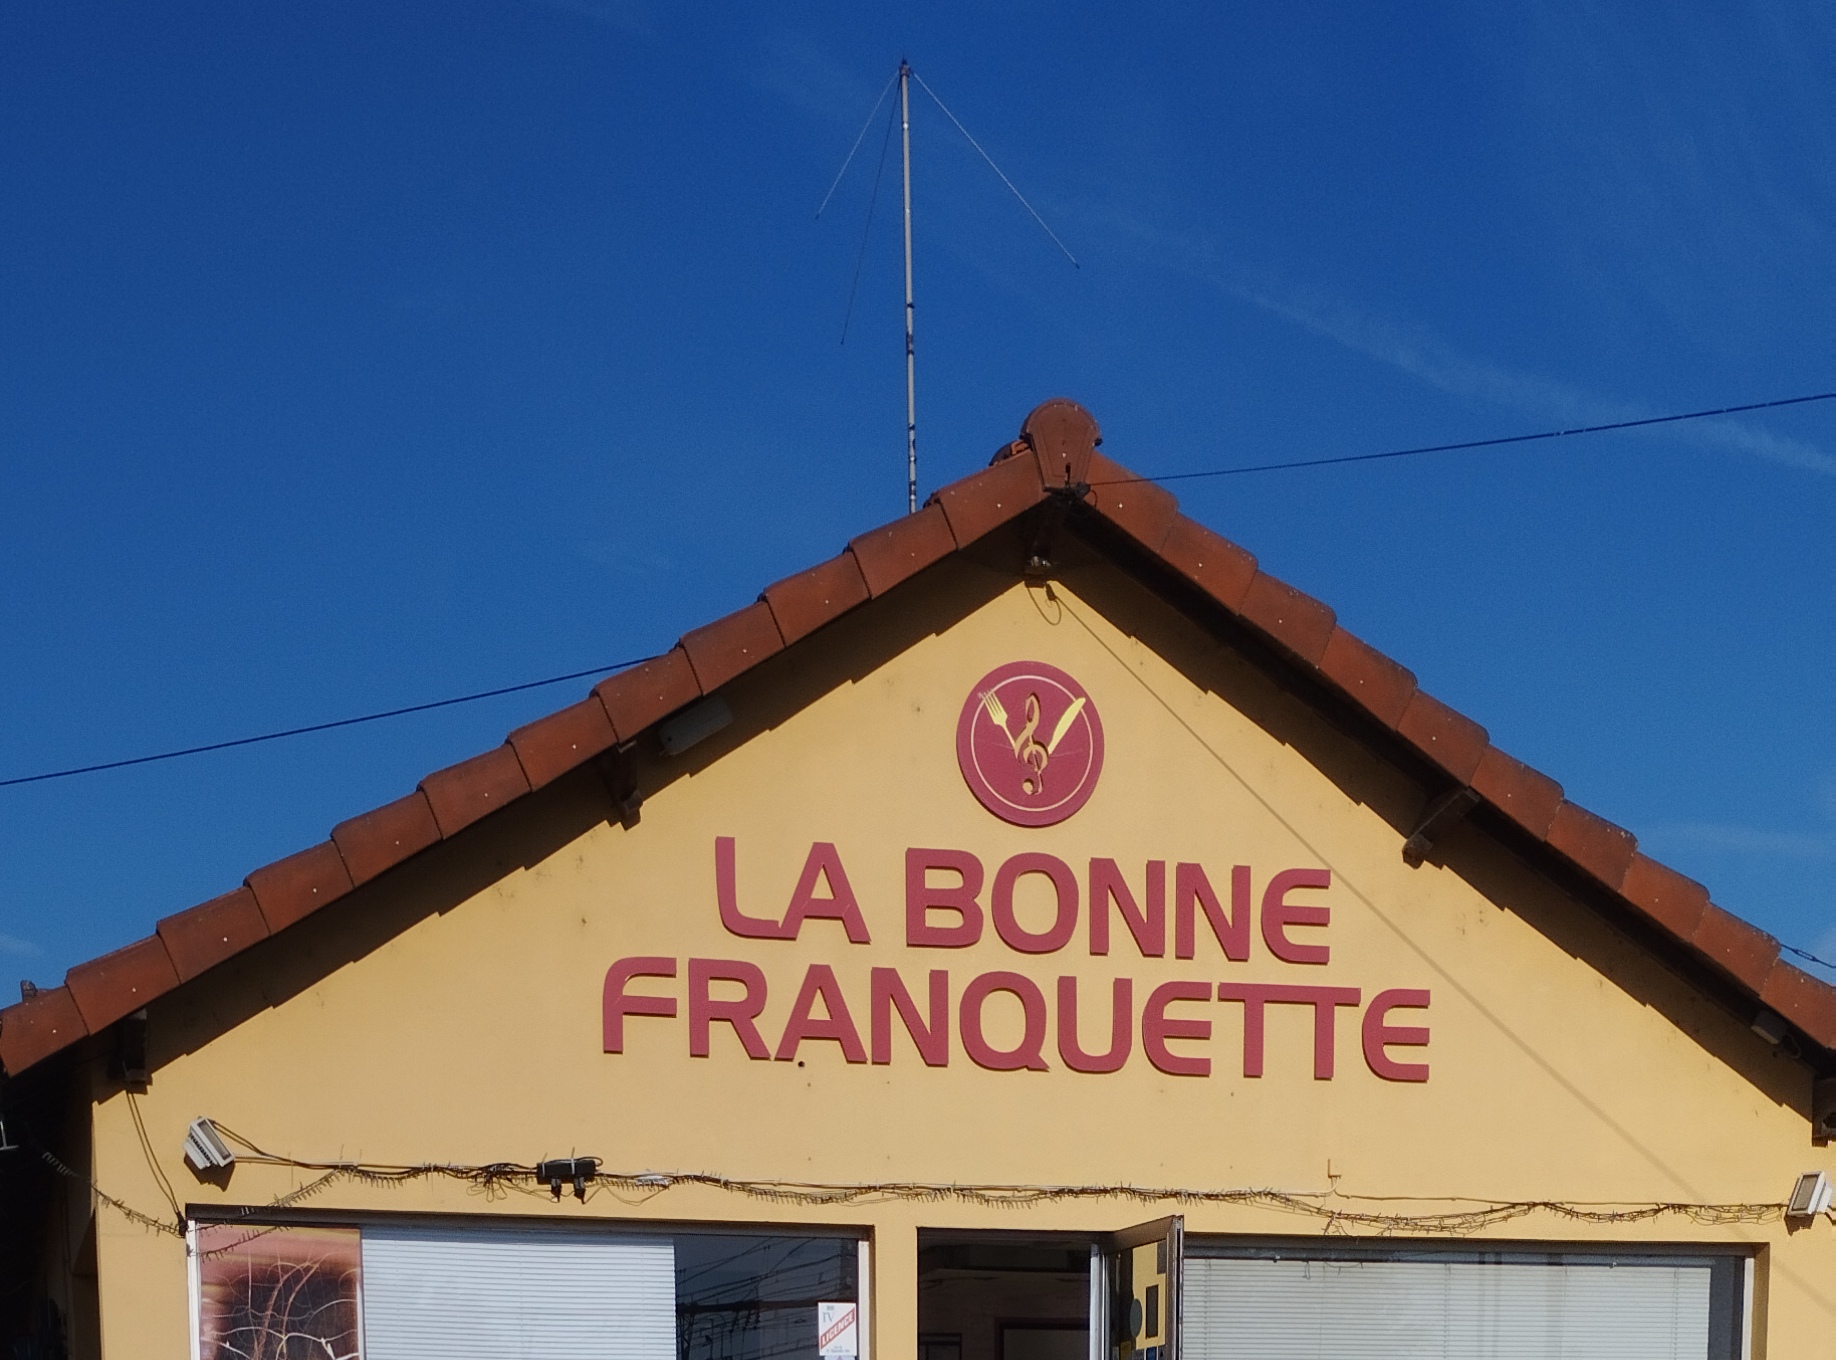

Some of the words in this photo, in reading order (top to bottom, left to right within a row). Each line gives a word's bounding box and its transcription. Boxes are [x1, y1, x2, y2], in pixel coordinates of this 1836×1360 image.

[715, 837, 871, 943] LA
[905, 848, 1332, 965] BONNE
[602, 956, 1431, 1083] FRANQUETTE
[821, 1311, 855, 1346] LICENCE
